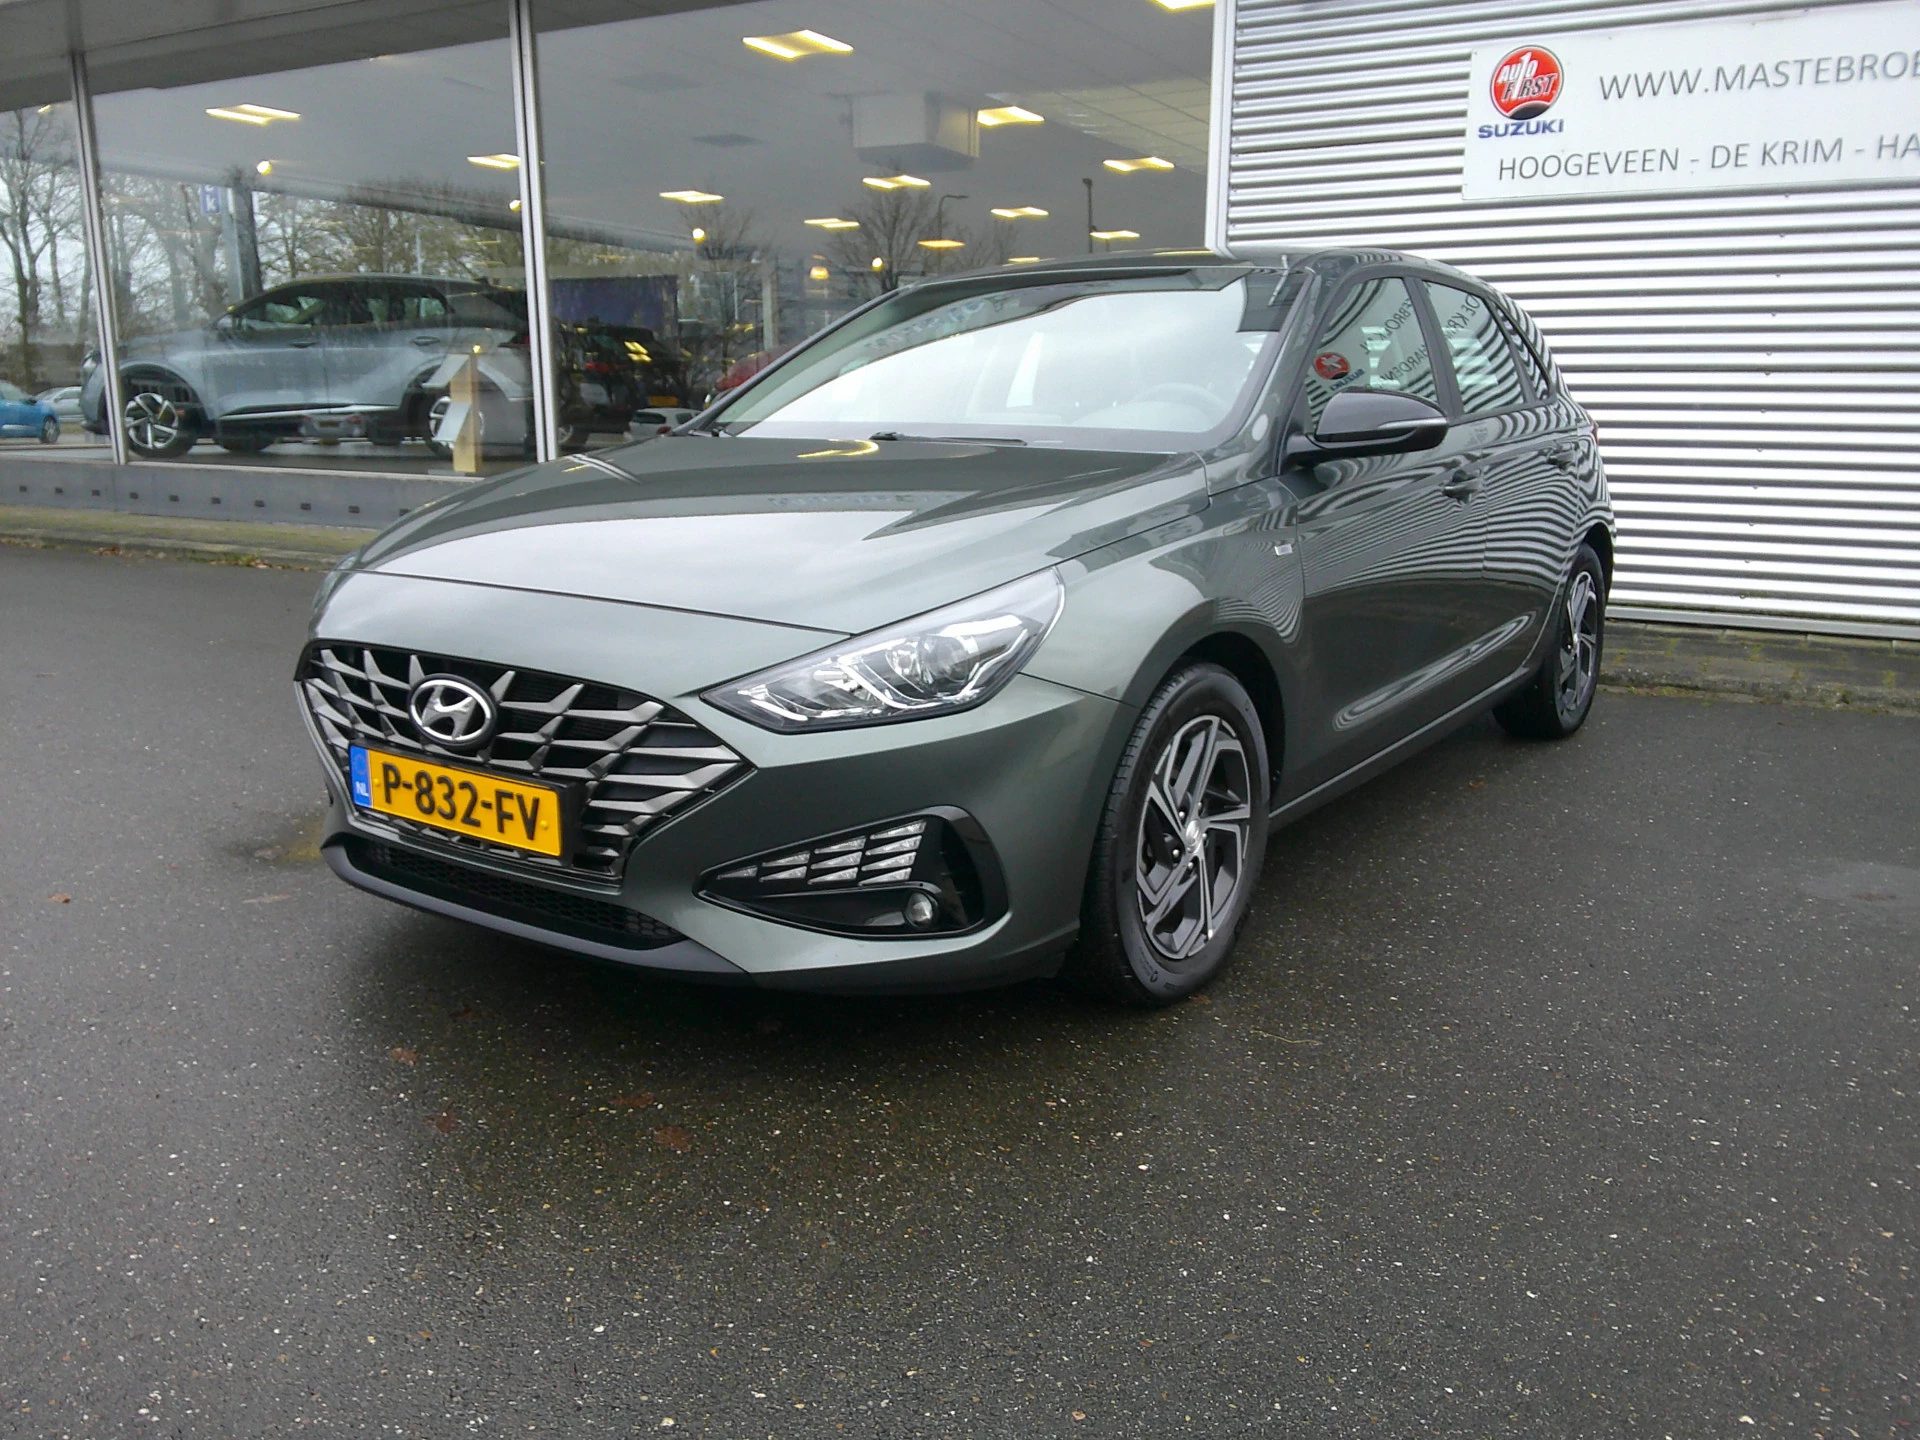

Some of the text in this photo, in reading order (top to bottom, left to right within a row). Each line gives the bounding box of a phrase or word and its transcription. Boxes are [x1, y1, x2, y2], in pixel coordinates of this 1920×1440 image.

[1478, 119, 1564, 138] SUZUKI
[1499, 147, 1680, 181] HOOGEVEEN
[1711, 143, 1750, 169] DE
[1761, 137, 1844, 166] KRIM
[1877, 133, 1920, 159] HA
[355, 781, 369, 797] NL
[381, 761, 540, 841] P-832-FV
